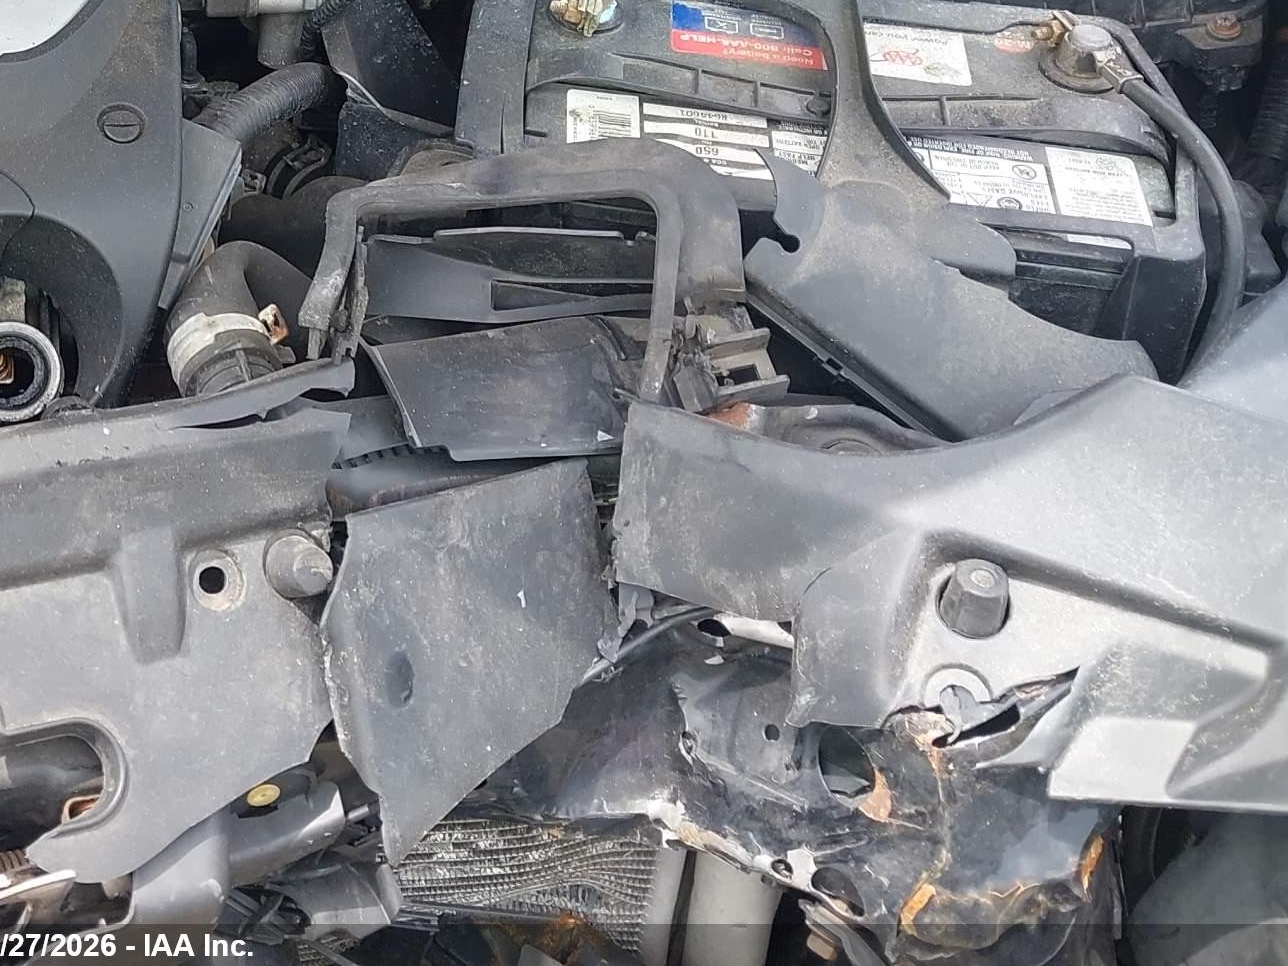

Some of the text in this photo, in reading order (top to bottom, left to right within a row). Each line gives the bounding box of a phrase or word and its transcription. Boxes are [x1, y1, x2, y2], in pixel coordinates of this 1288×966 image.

[679, 34, 814, 56] Call: 800-AAA-HELP
[694, 127, 719, 139] 110
[695, 146, 719, 156] 650
